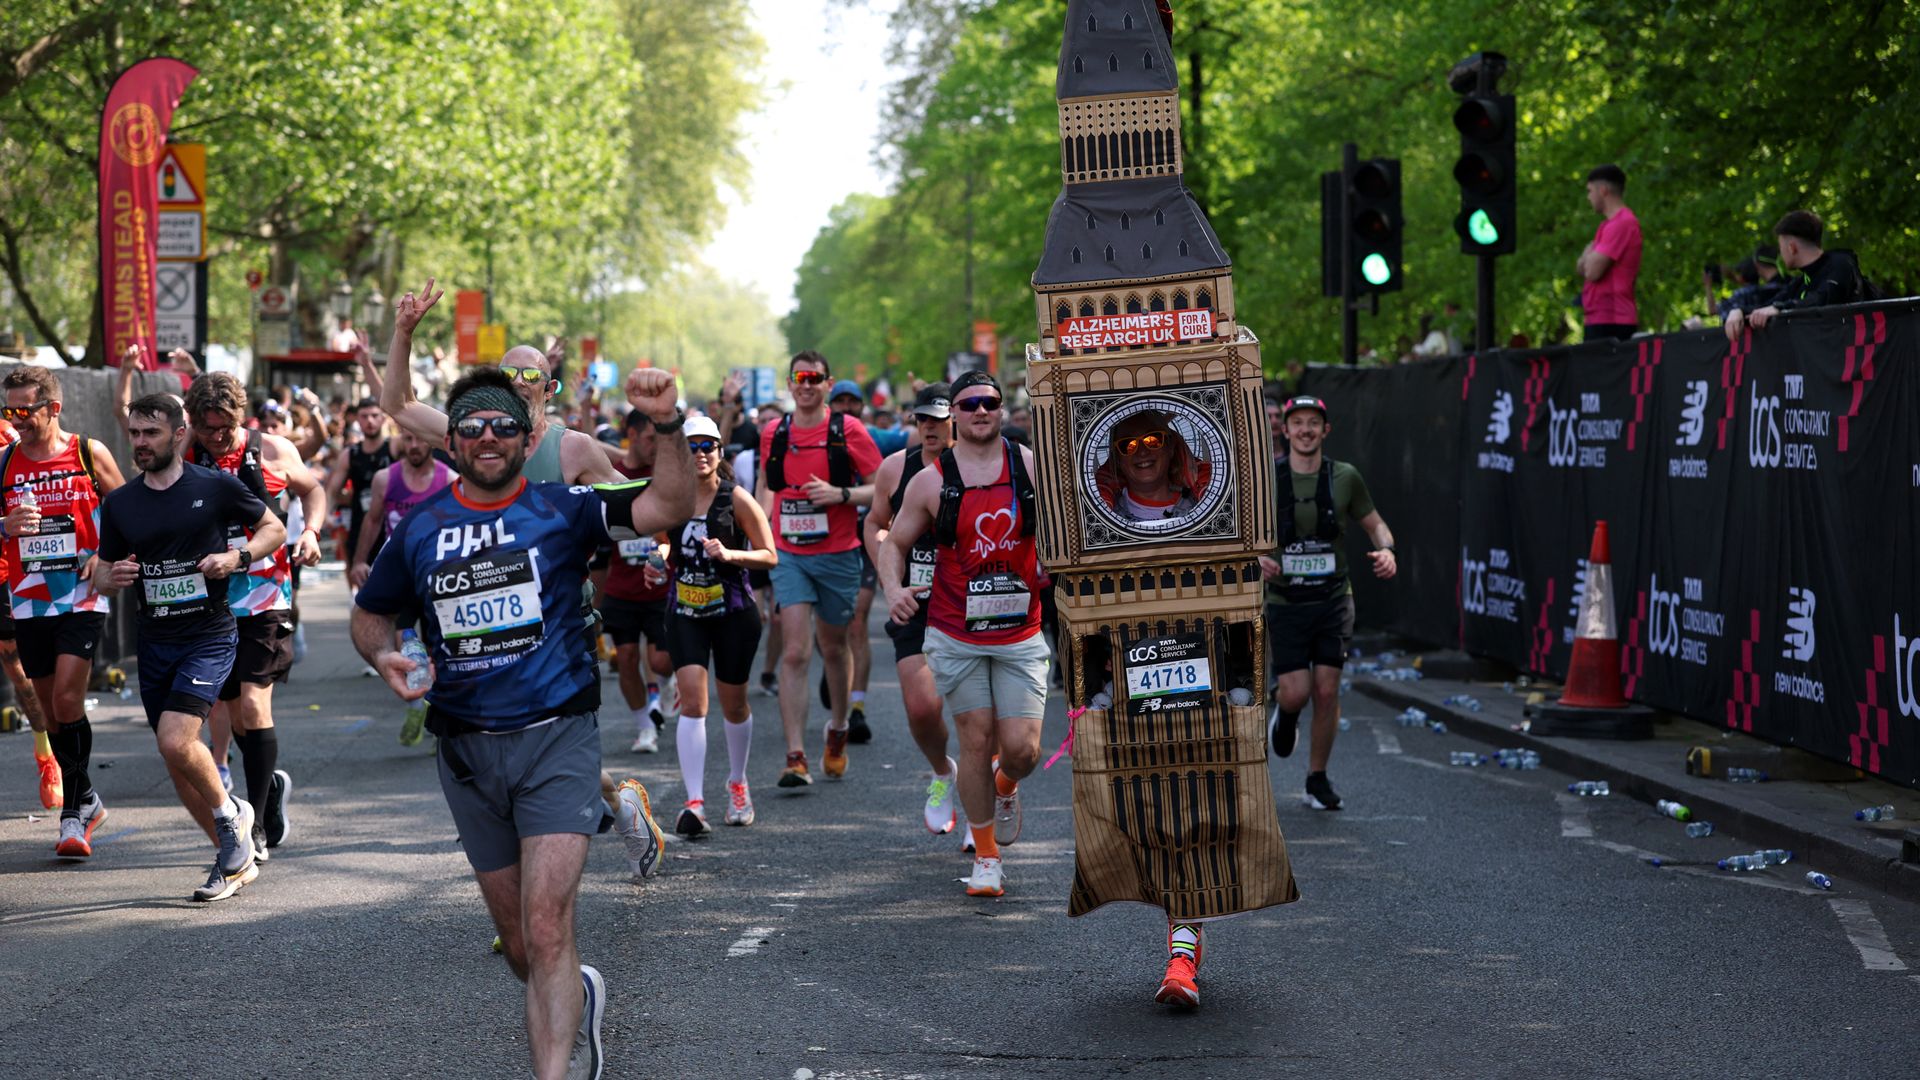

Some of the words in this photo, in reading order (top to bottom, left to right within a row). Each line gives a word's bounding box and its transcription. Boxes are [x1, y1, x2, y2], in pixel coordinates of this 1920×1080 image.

[113, 190, 133, 356] PLUMSTEAD
[1068, 313, 1175, 333] ALZHEIMER'S
[1182, 314, 1199, 325] FOR
[1200, 313, 1208, 323] A
[1061, 330, 1149, 348] RESEARCH
[1152, 328, 1175, 342] UK
[1182, 325, 1208, 336] CURE
[1548, 397, 1578, 467] tcs
[1750, 379, 1781, 468] tcs
[15, 469, 76, 493] BARRY
[64, 489, 90, 501] Care
[27, 539, 65, 555] 49481
[912, 547, 932, 562] tcs
[142, 562, 162, 576] tcs
[163, 560, 197, 570] CONSULTANCY
[471, 561, 494, 572] TATA
[472, 562, 525, 580] CONSULTANCY
[980, 560, 1012, 573] JOEL
[1291, 557, 1327, 571] 77979
[151, 579, 196, 599] 74845
[435, 571, 471, 595] tcs
[474, 574, 508, 588] SERVICES
[969, 580, 993, 592] tcs
[1683, 577, 1703, 601] TATA
[453, 594, 524, 629] 45078
[978, 598, 1021, 614] 17957
[1649, 572, 1681, 658] tcs
[483, 640, 501, 653] new
[502, 634, 536, 649] balance
[1160, 642, 1197, 653] CONSULTANC
[1161, 650, 1187, 659] SERVICES
[1894, 612, 1920, 721] tc
[1141, 665, 1197, 690] 41718
[1775, 671, 1791, 695] new
[1791, 672, 1825, 704] balance
